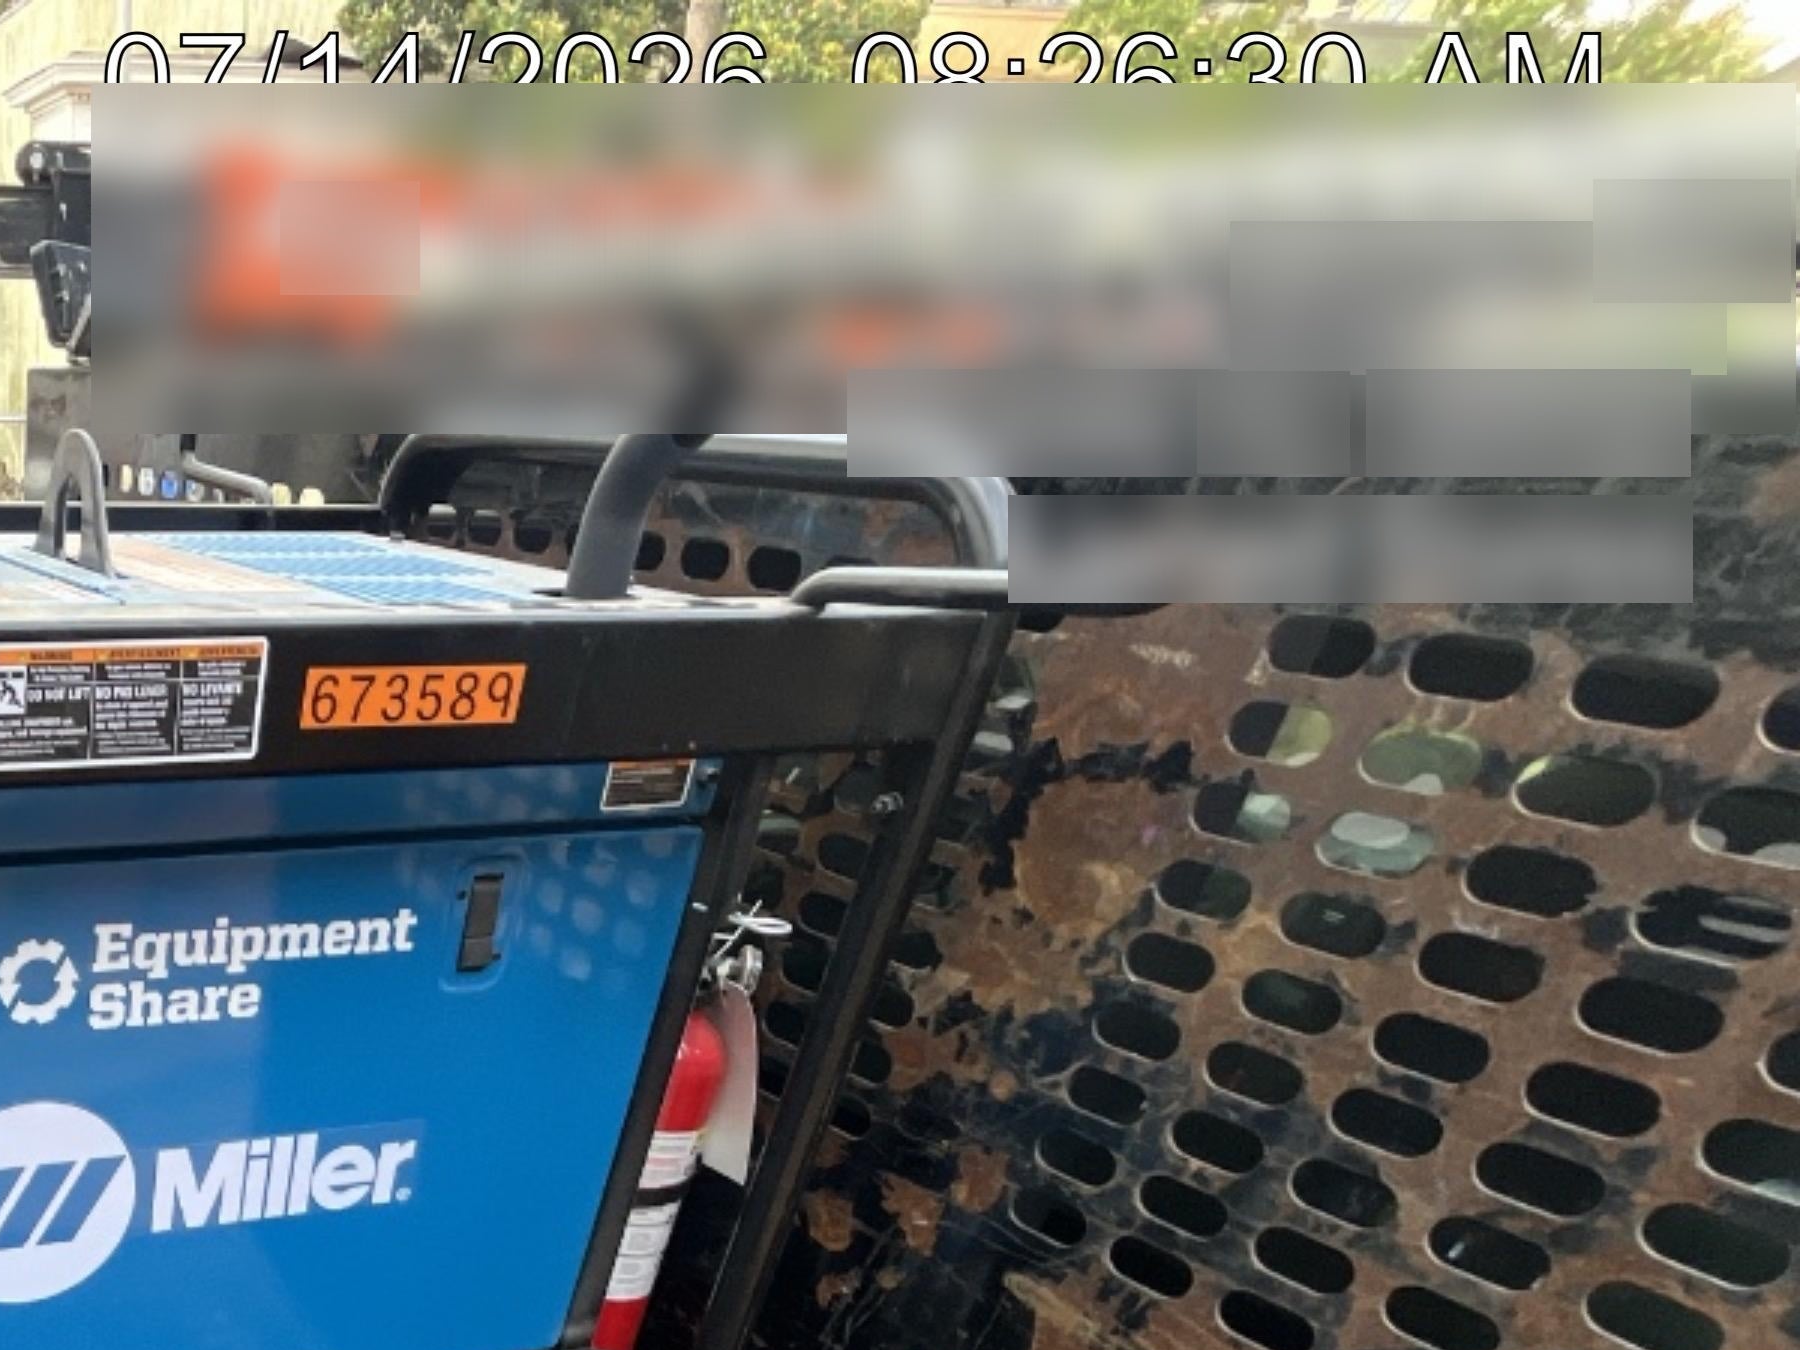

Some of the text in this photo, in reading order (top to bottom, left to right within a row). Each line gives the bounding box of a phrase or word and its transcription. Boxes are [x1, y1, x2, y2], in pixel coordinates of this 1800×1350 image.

[311, 671, 514, 724] 673589
[92, 908, 418, 979] Equipment
[88, 980, 262, 1030] Share
[151, 1131, 418, 1234] Miller
